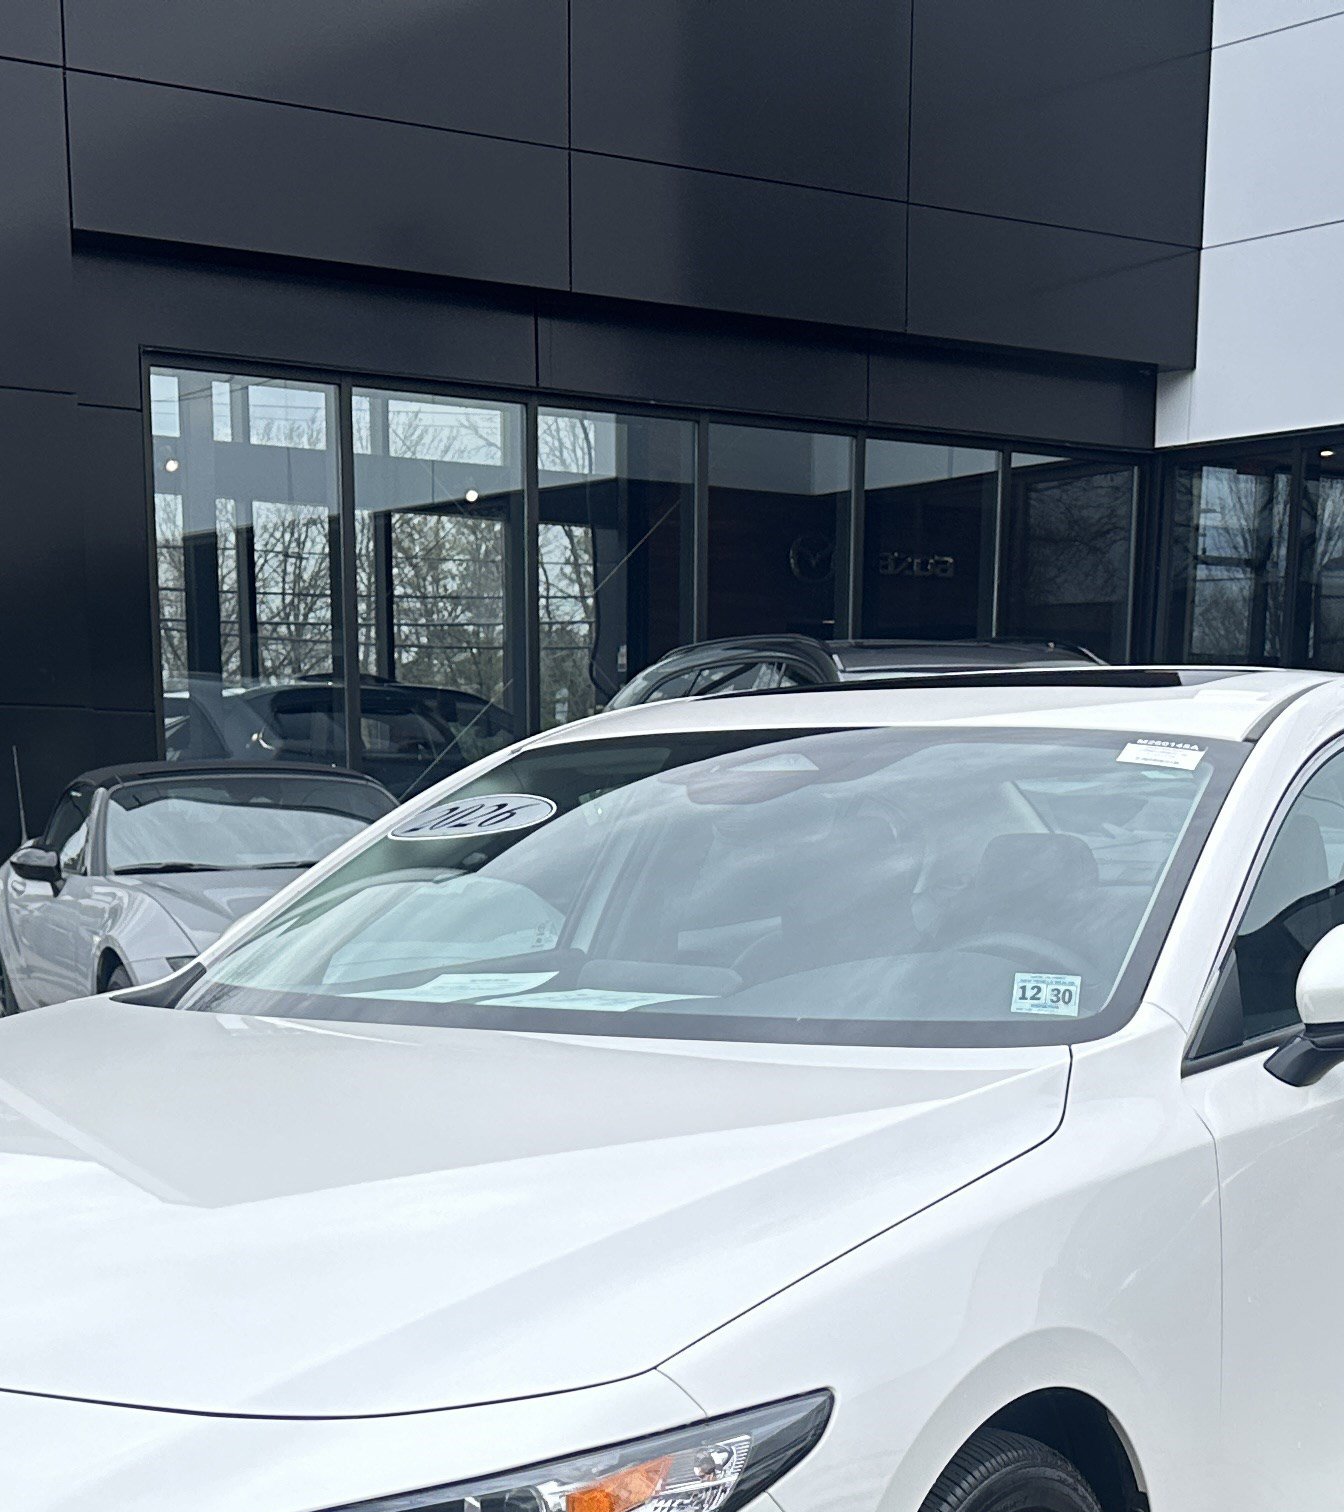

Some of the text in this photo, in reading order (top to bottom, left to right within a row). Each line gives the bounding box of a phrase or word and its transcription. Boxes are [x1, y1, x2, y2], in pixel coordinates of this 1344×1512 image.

[401, 803, 541, 834] 2026
[1018, 985, 1073, 1005] 12 30
